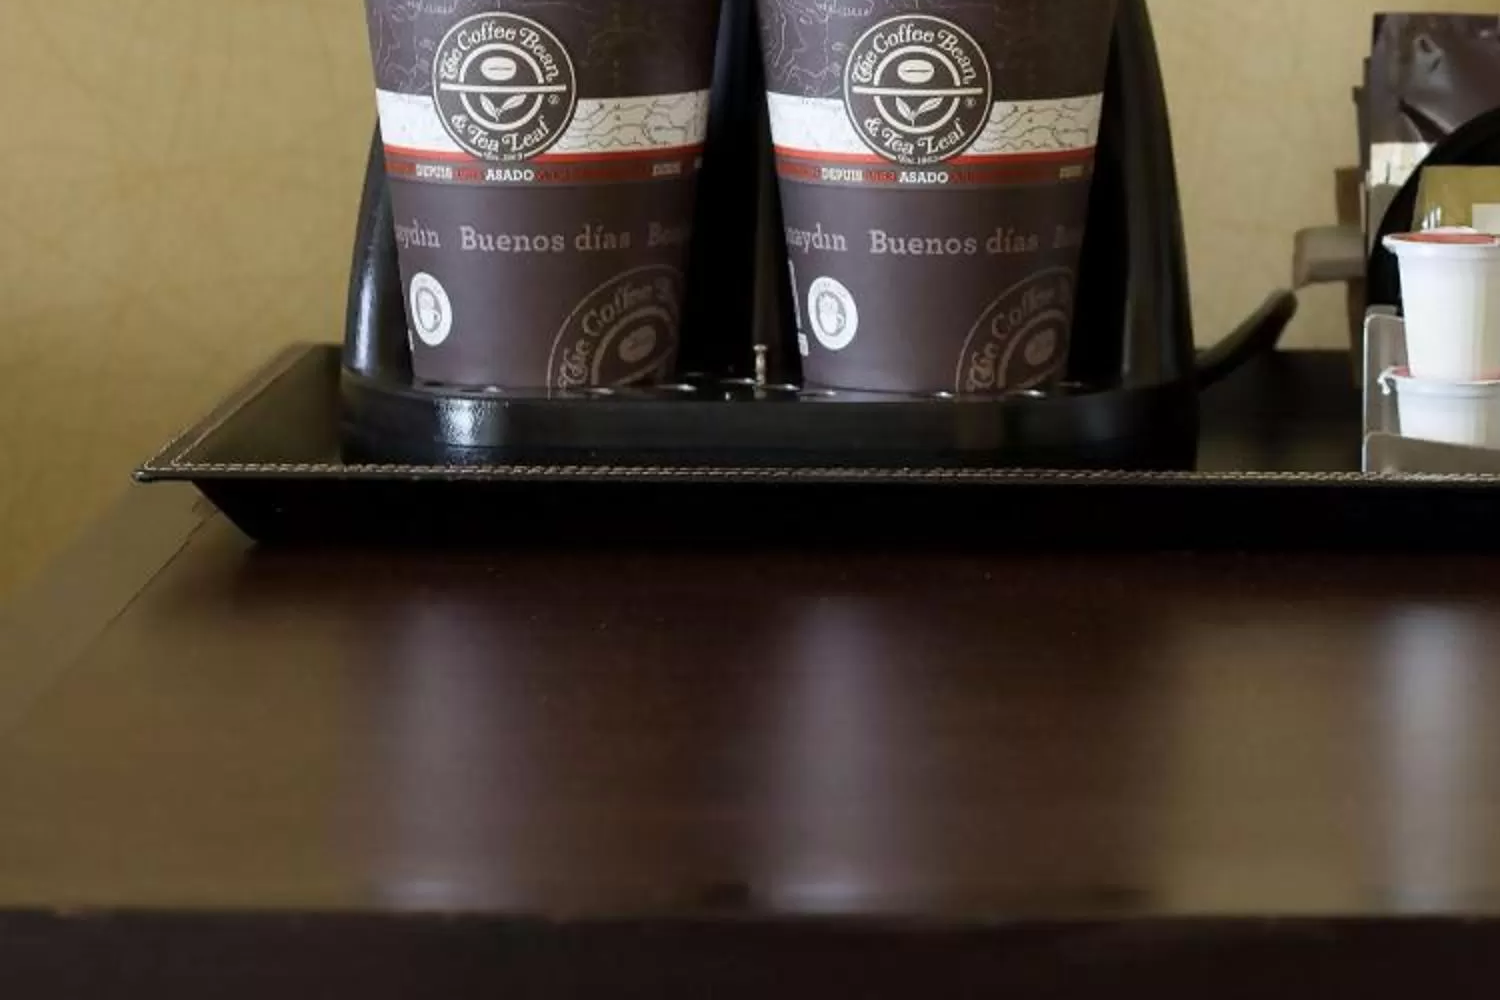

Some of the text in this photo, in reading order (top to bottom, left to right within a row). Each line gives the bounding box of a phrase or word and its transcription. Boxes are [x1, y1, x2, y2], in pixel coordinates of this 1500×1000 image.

[457, 20, 517, 51] Coffee
[519, 27, 560, 83] Bean
[851, 23, 977, 85] The Coffee Bean
[467, 123, 499, 152] Tea
[502, 115, 550, 152] Leaf
[881, 127, 915, 154] Tea
[917, 117, 966, 154] Leaf
[485, 168, 535, 182] ASADO
[898, 171, 950, 184] ASADO
[459, 224, 565, 252] Buenos
[574, 223, 631, 251] días
[868, 228, 977, 256] Buenos
